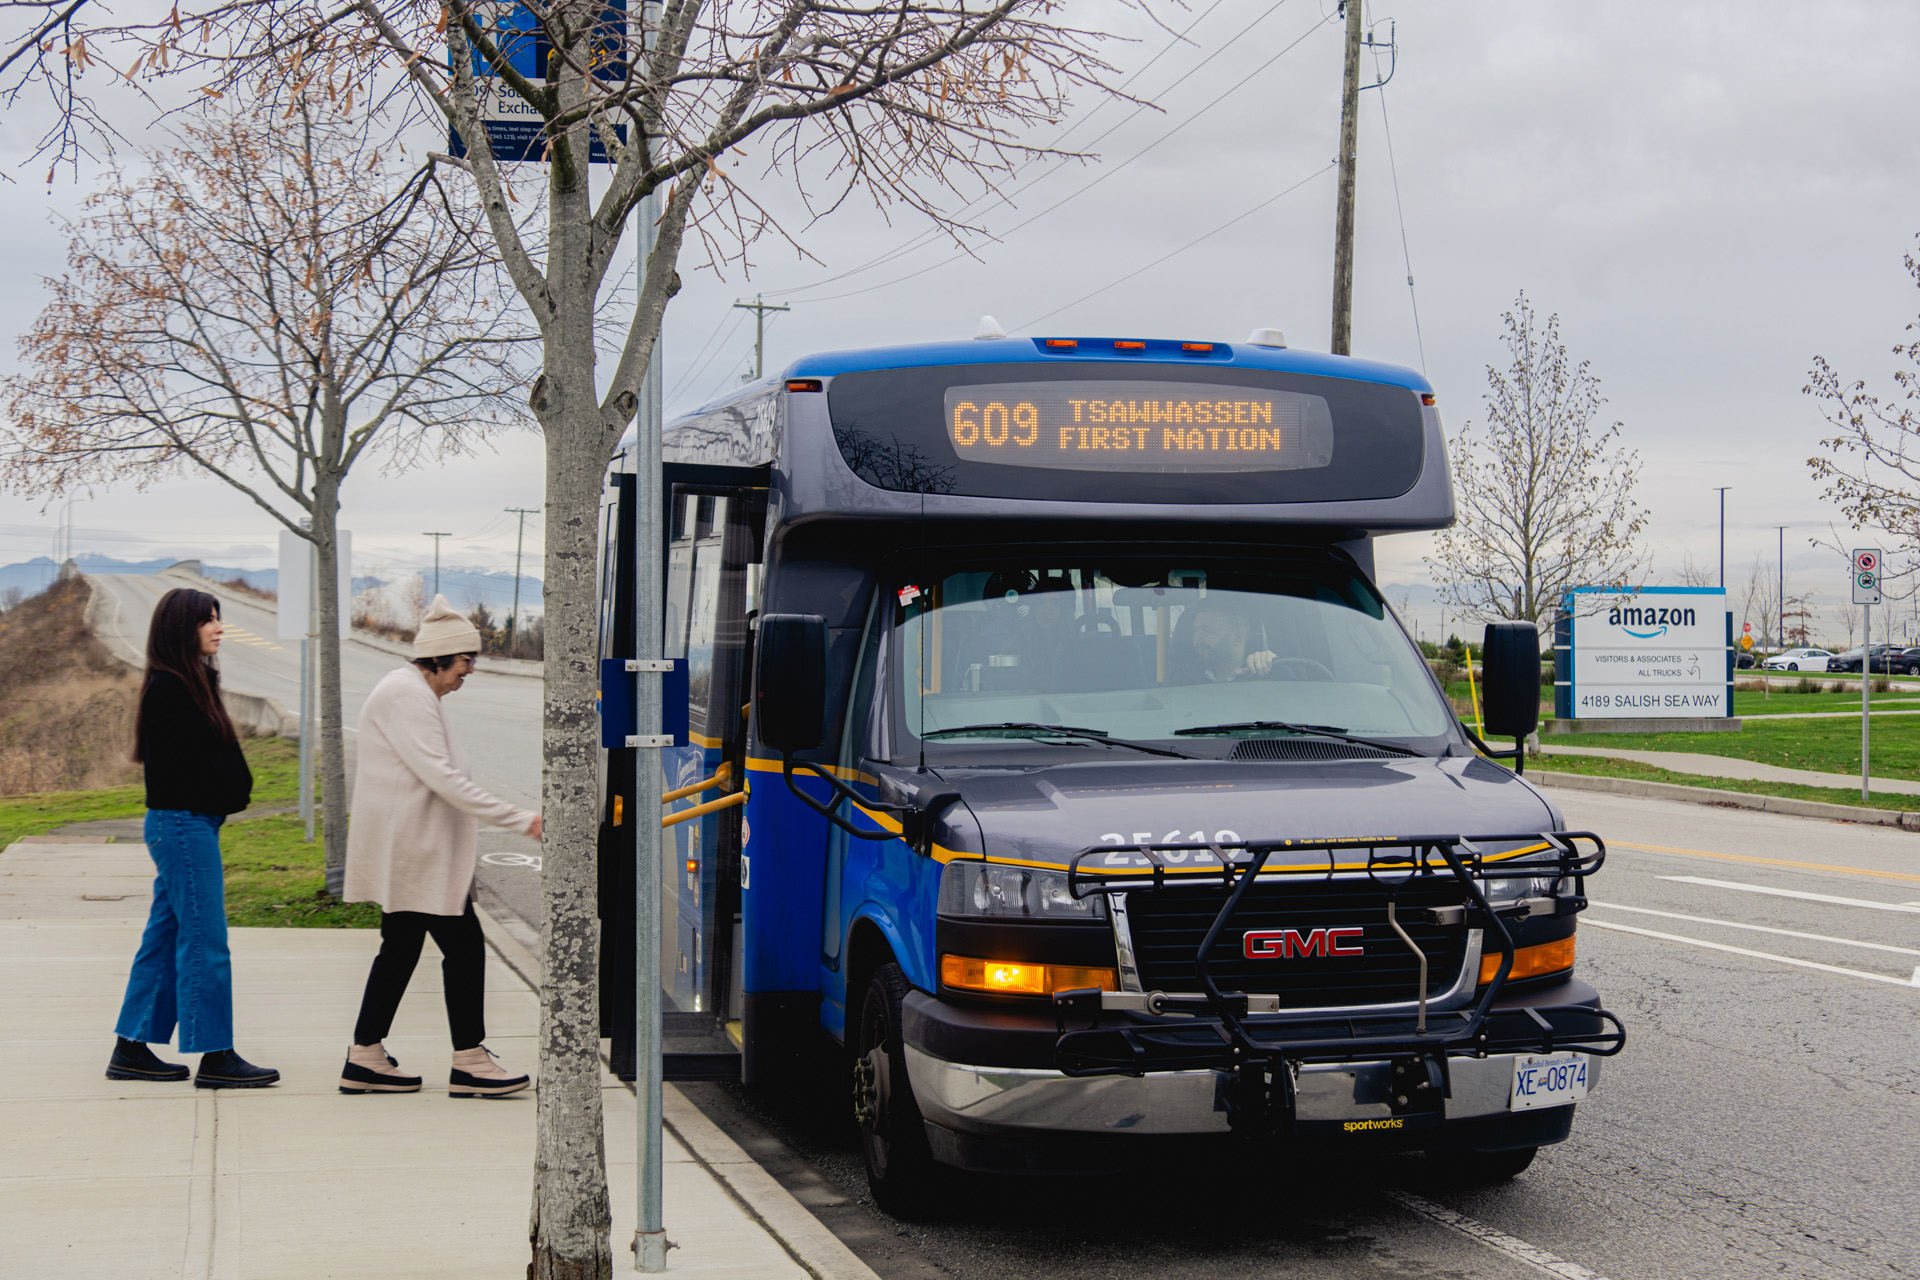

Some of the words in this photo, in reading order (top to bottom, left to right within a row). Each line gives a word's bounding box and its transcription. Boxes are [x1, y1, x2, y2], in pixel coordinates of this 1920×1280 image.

[498, 101, 541, 115] Excha
[954, 402, 1037, 446] 609
[1069, 400, 1272, 424] TSAWWASSEN
[1060, 427, 1149, 450] FIRST
[1163, 428, 1281, 451] NATION
[1608, 607, 1696, 627] amazon
[1595, 655, 1629, 663] VISITORS
[1630, 655, 1635, 663] &
[1636, 655, 1682, 663] ASSOCIATES
[1638, 669, 1651, 677] ALL
[1653, 669, 1682, 677] TRUCKS
[1581, 695, 1610, 707] 4189
[1614, 695, 1660, 707] SALISH
[1664, 695, 1690, 707] SEA
[1692, 695, 1720, 707] WAY
[1100, 829, 1241, 866] 25619
[1243, 926, 1364, 959] GMC
[1521, 1060, 1544, 1069] Beautiful
[1544, 1058, 1560, 1067] British
[1561, 1056, 1584, 1064] Columbia
[1343, 1118, 1403, 1132] sportworks
